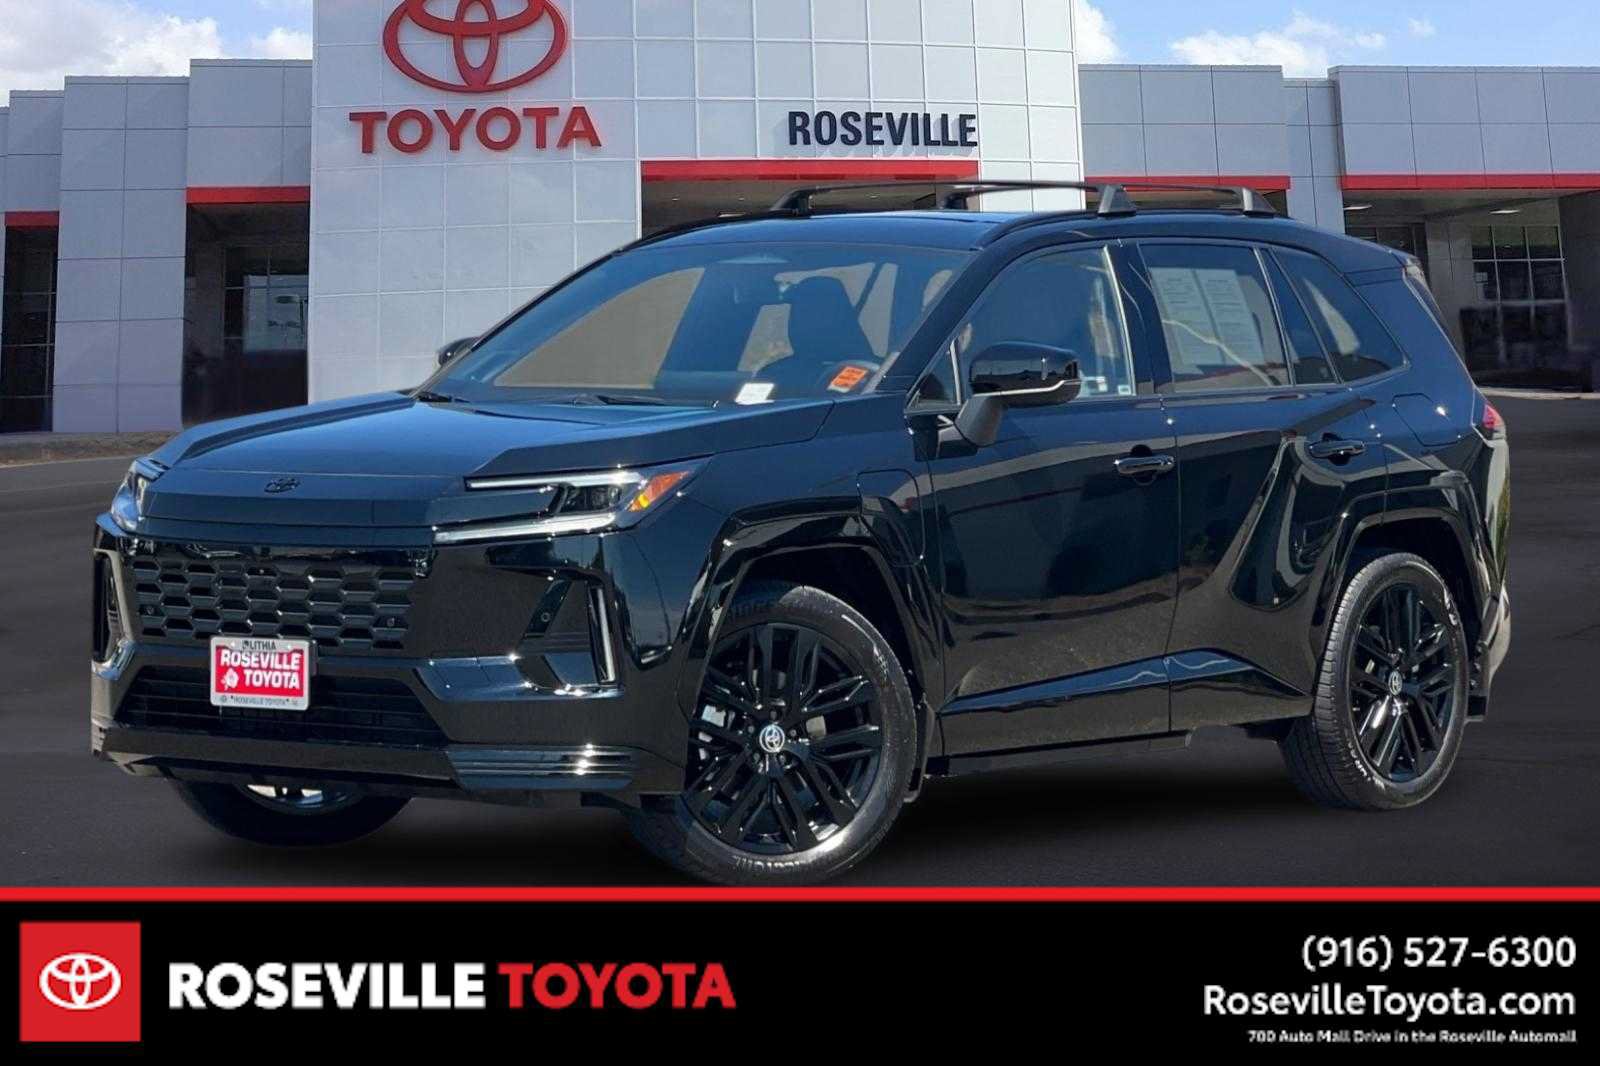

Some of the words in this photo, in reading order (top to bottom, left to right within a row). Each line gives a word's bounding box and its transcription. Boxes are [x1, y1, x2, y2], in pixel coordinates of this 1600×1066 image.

[349, 106, 602, 154] TOYOTA
[788, 110, 979, 147] ROSEVILLE
[250, 640, 277, 650] LITHIA
[220, 648, 302, 670] ROSEVILLE
[243, 669, 300, 689] TOYOTA
